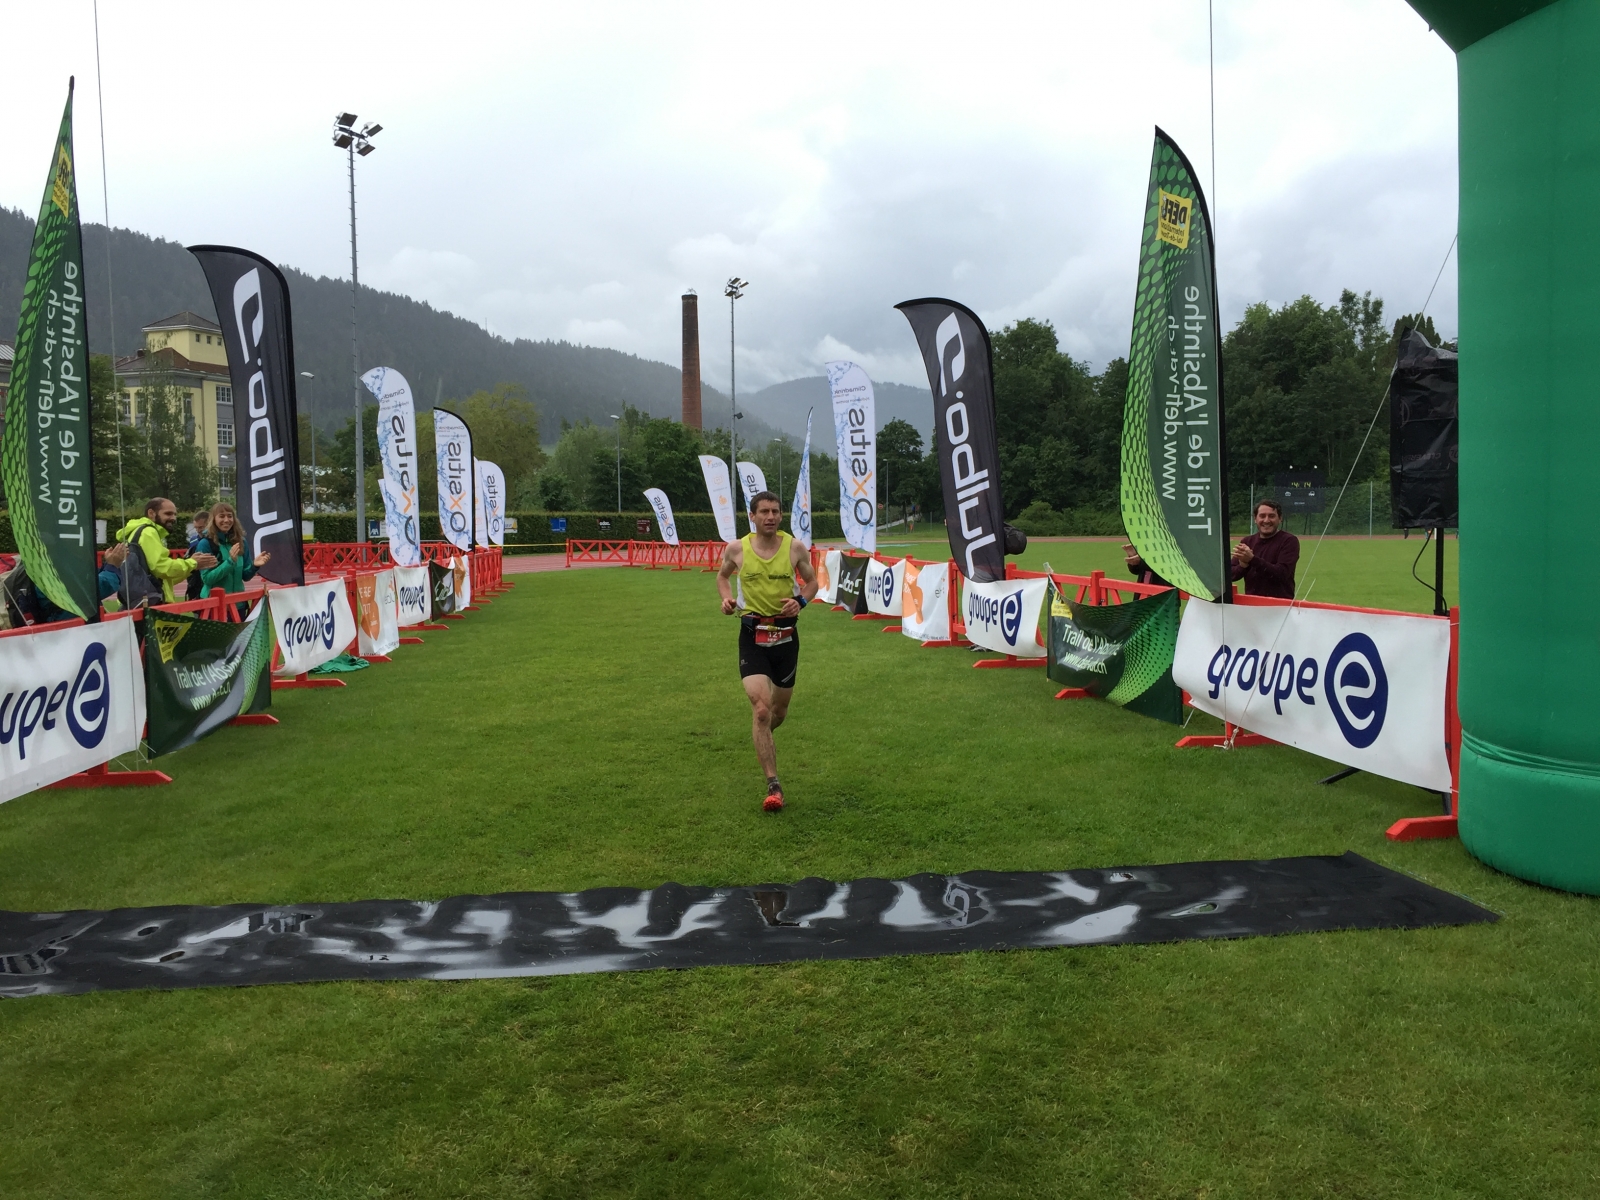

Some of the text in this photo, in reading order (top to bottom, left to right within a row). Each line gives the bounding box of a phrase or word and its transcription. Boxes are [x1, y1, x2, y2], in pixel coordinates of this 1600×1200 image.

[968, 591, 999, 633] groupe
[1062, 624, 1084, 648] Trail
[191, 665, 204, 687] de
[1207, 644, 1318, 716] groupe
